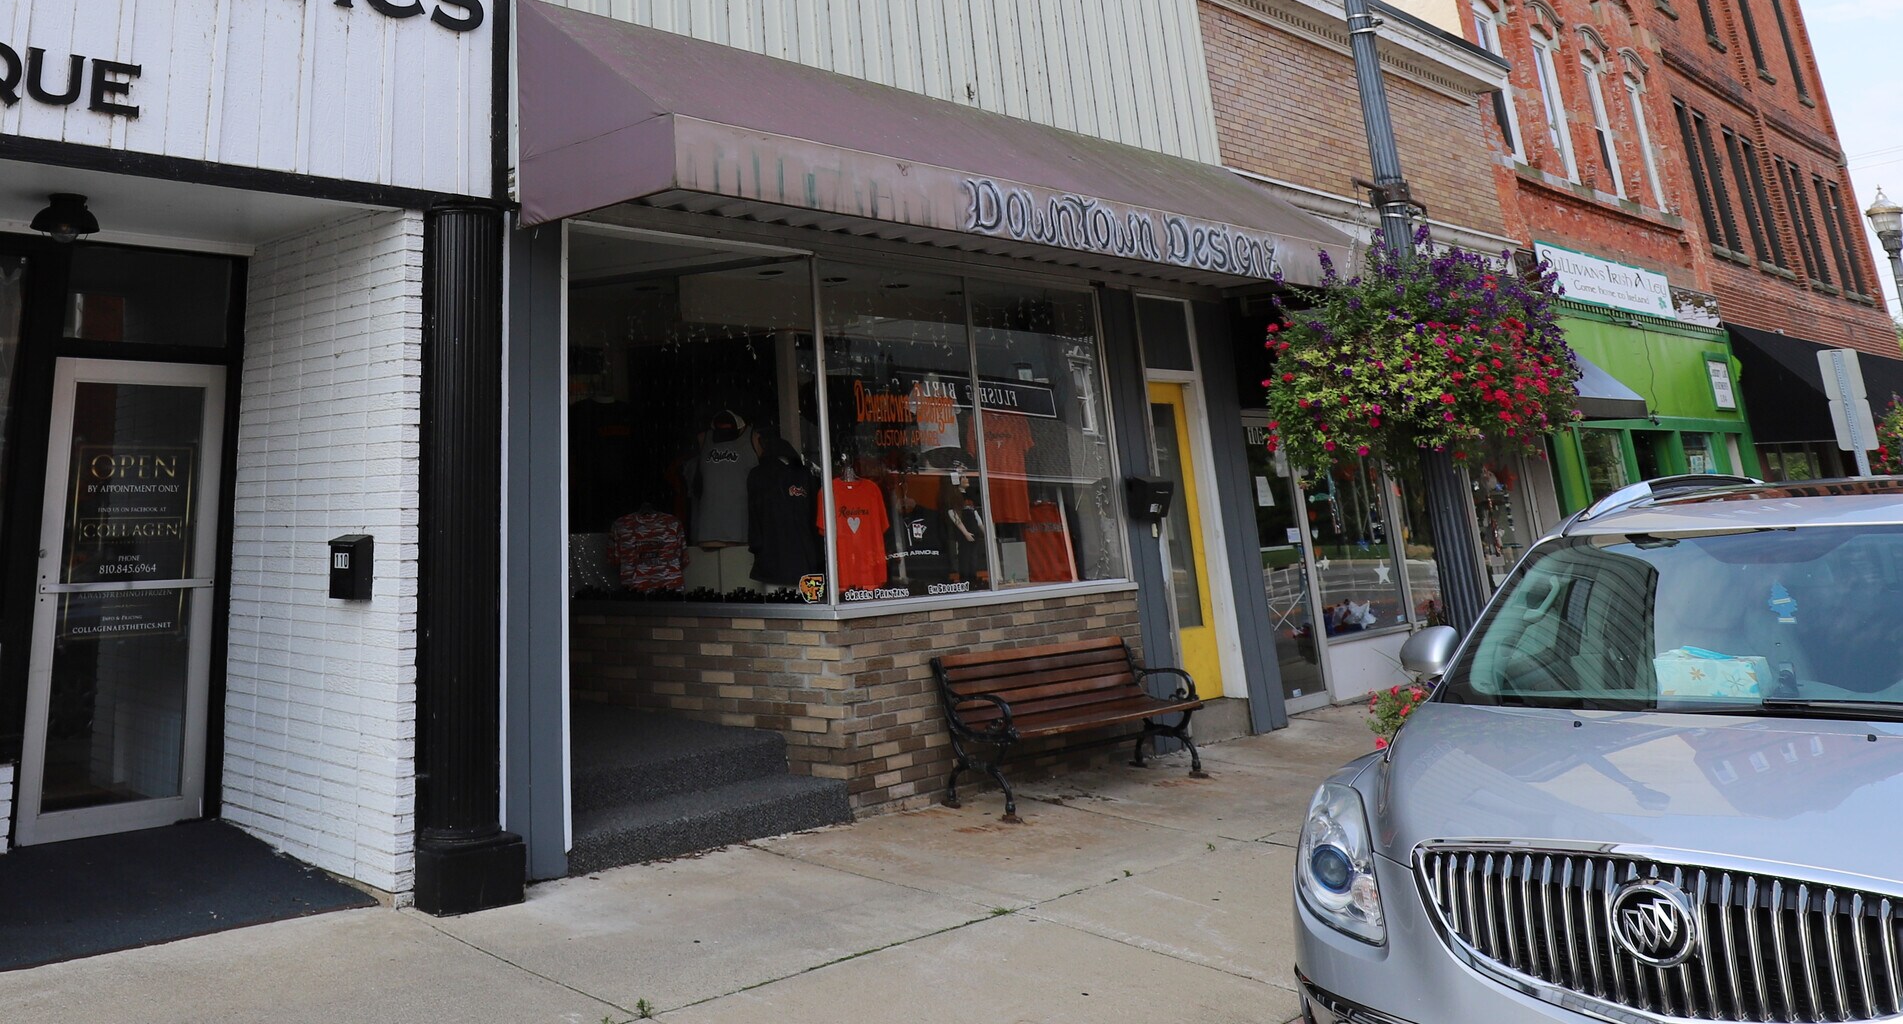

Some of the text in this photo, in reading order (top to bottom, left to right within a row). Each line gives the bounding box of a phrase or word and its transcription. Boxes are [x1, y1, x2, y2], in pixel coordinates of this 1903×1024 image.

[1597, 284, 1616, 297] home
[1616, 290, 1626, 299] to
[1626, 290, 1650, 305] Ireland
[854, 379, 913, 423] Downtown
[876, 429, 907, 447] CUSTOM
[706, 448, 740, 463] Raiders
[91, 454, 177, 479] OPEN
[87, 484, 179, 493] BY APPOINTMENT ONLY
[839, 506, 870, 518] Raiders
[83, 522, 178, 538] COLLAGEN
[335, 553, 349, 568] 110
[99, 563, 157, 575] 810.845.6964
[72, 622, 172, 634] COLLAGENAESTHETICS.NET
